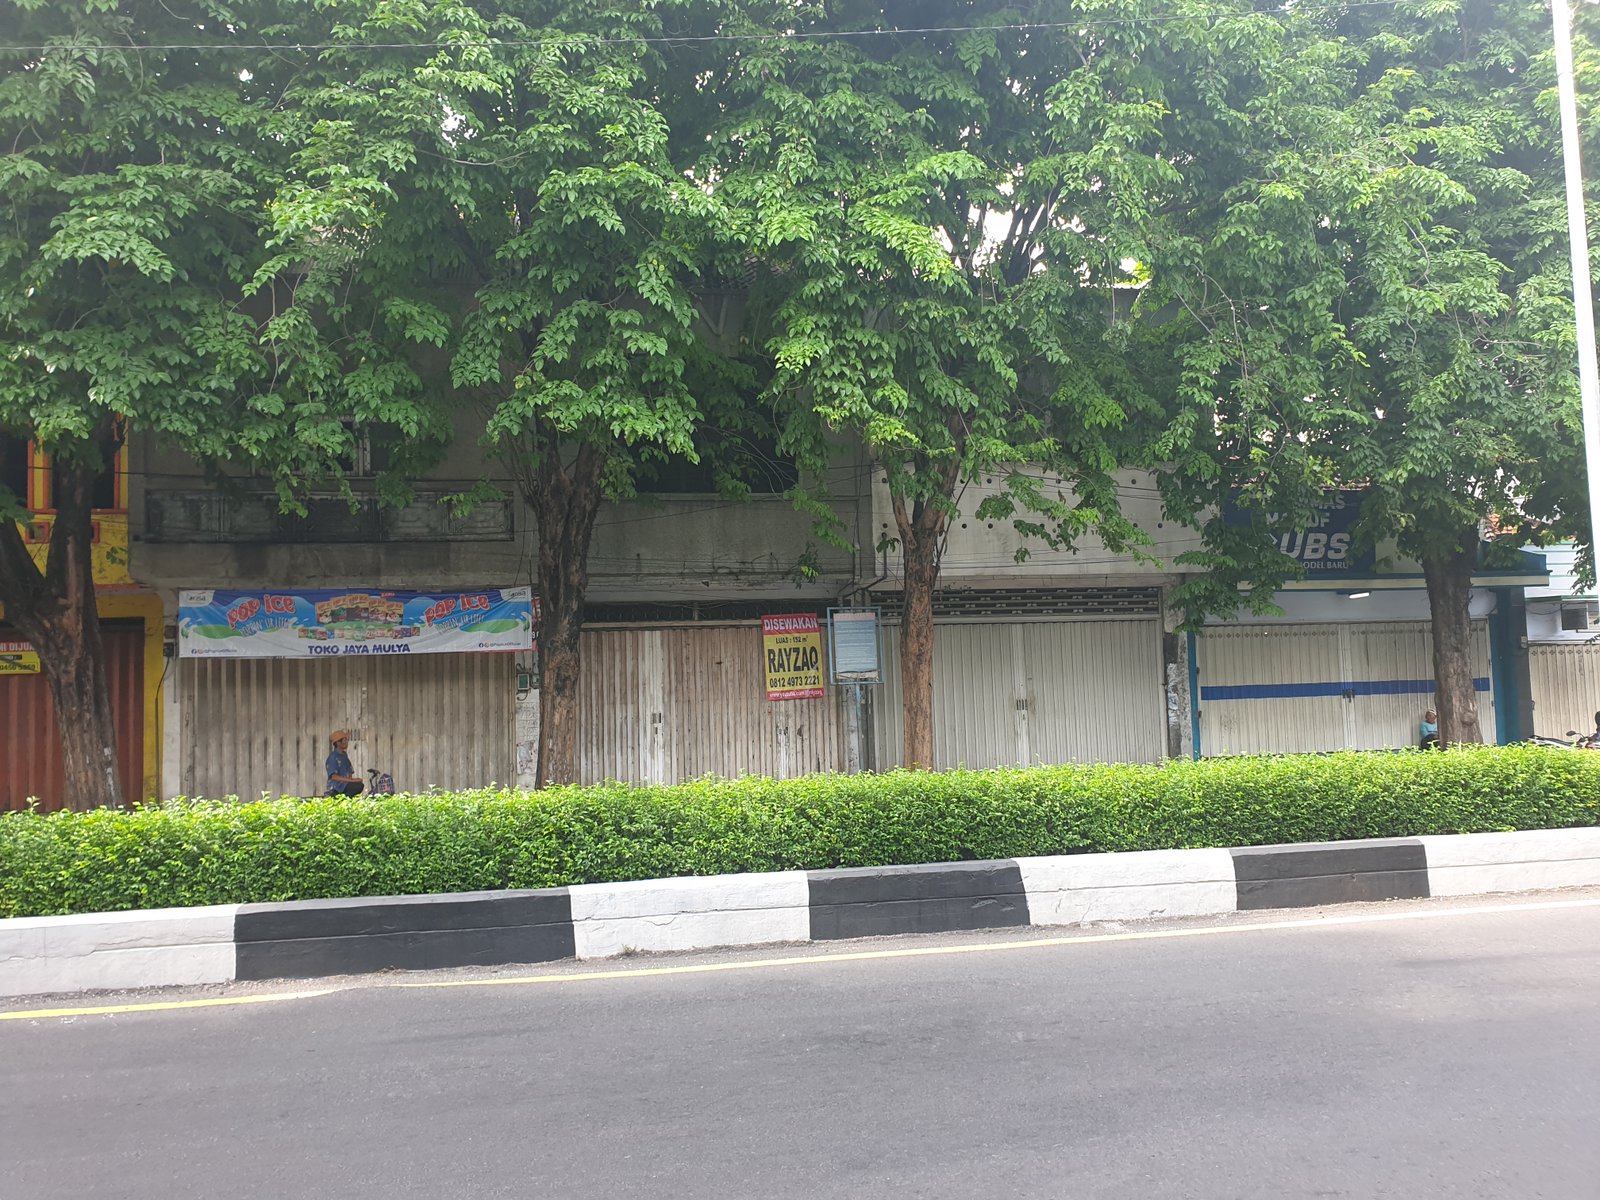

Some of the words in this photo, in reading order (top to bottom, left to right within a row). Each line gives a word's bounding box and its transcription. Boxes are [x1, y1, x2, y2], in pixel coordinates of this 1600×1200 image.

[1279, 530, 1351, 559] UBS
[1301, 561, 1325, 569] ODEL
[1326, 561, 1348, 569] BARU
[226, 597, 261, 630] POP
[424, 597, 457, 628] POP
[764, 617, 818, 631] DISEWAKAN
[308, 645, 340, 655] TOKO
[343, 644, 369, 654] JAYA
[372, 643, 411, 654] MULYA
[767, 645, 819, 674] RAYZAQ
[770, 678, 786, 688] 0812
[787, 676, 803, 687] 4973
[804, 674, 820, 685] 2221
